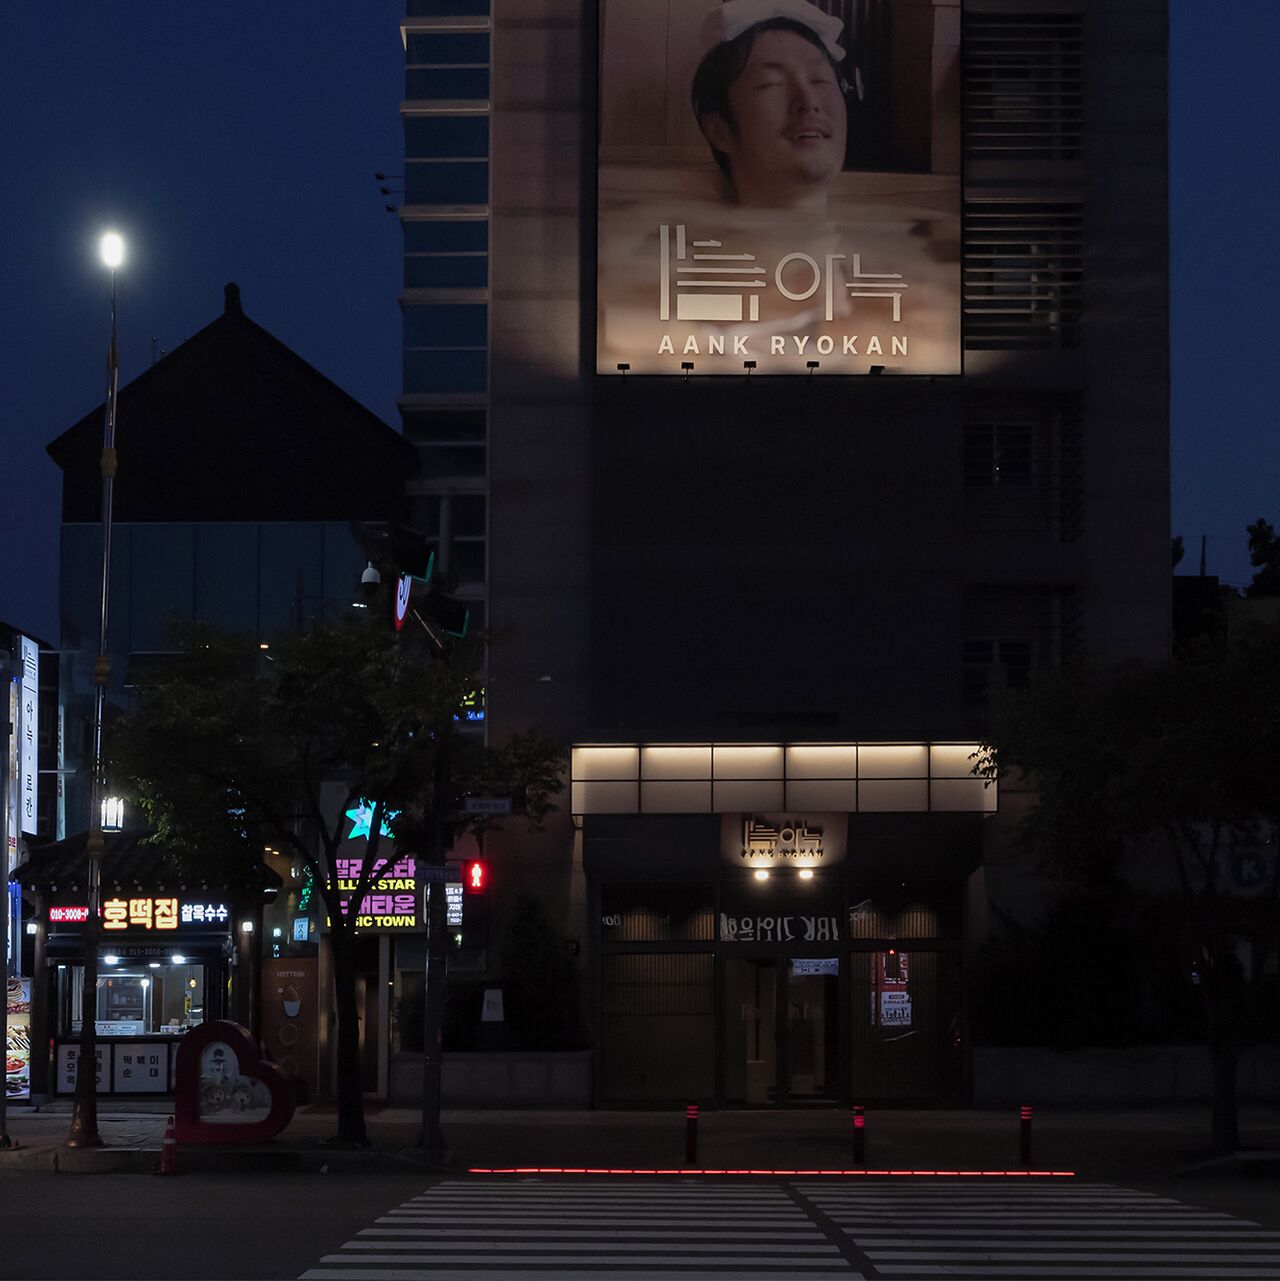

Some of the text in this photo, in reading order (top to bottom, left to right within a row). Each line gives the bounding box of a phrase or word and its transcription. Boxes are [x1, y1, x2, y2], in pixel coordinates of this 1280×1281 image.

[658, 335, 908, 356] AANK RYOKAN
[377, 879, 416, 890] STAR
[102, 897, 228, 930] 호떡집 찰옥수수
[375, 915, 416, 927] TOWN
